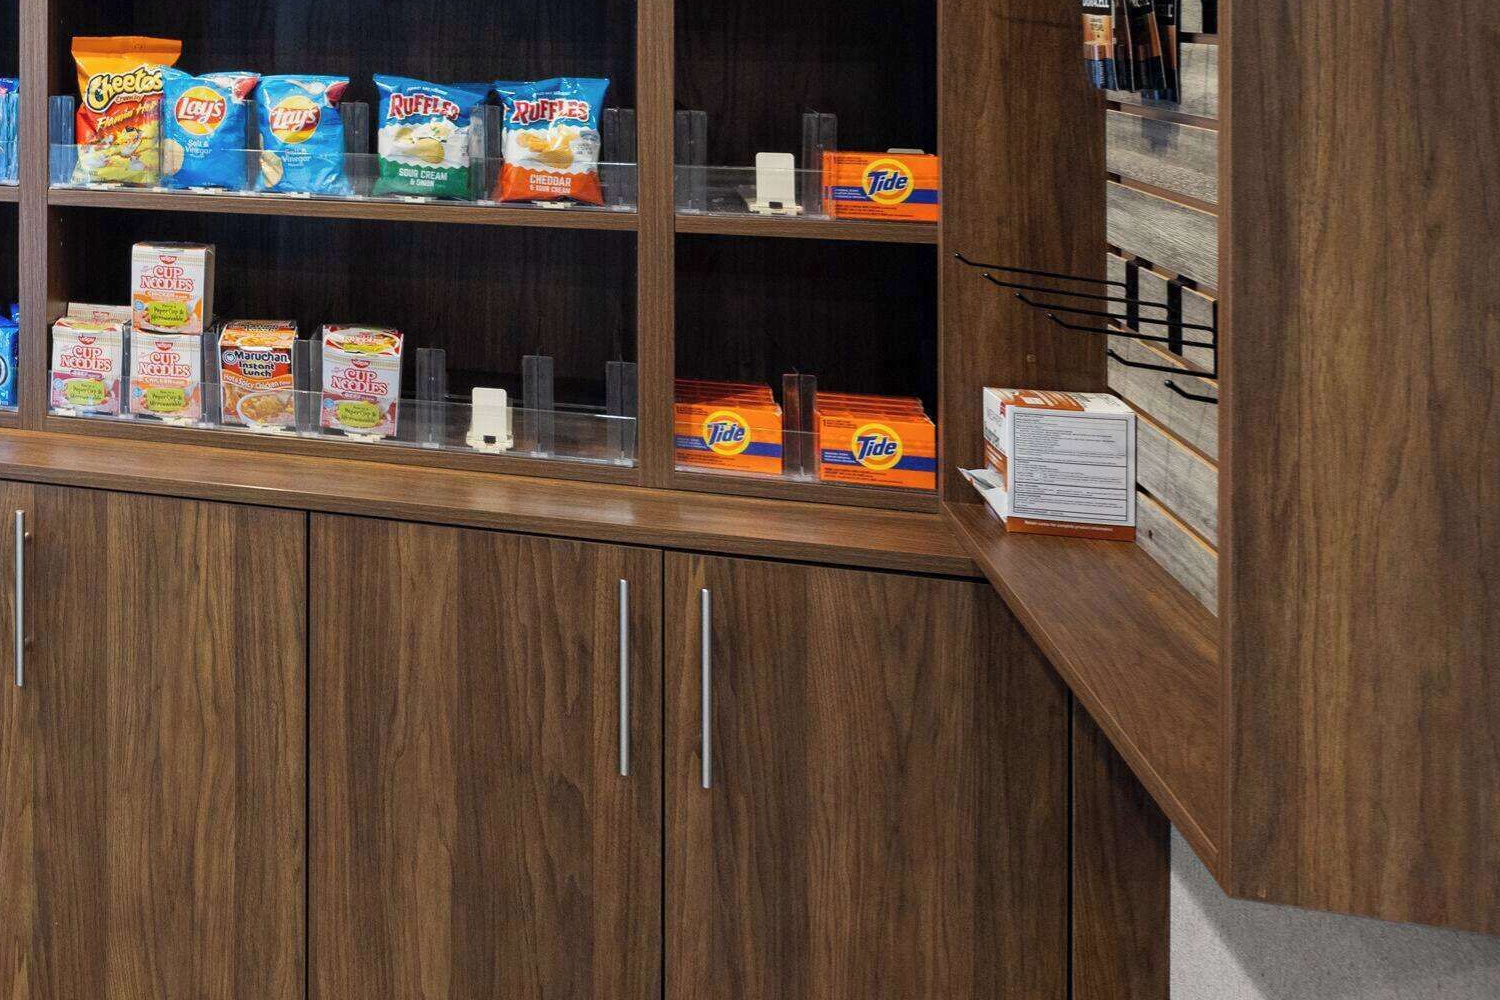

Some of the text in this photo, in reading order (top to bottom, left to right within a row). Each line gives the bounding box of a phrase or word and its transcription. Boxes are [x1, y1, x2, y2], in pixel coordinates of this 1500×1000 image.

[87, 66, 164, 112] Cheetos
[177, 99, 224, 124] Lay's
[389, 93, 460, 121] RUFFLES
[512, 99, 590, 124] RUFFLES
[398, 168, 447, 181] SOUR CREAM
[529, 173, 572, 187] CHEDDAR
[867, 170, 909, 197] Tide
[153, 264, 185, 279] CUP
[140, 274, 194, 293] NOODLES
[72, 345, 103, 359] CUP
[150, 351, 181, 366] CUP
[235, 350, 289, 363] Maruchan
[60, 354, 113, 373] NOODLES
[137, 361, 191, 379] NOODLES
[238, 361, 275, 371] Instant
[243, 368, 273, 378] Lunch
[344, 368, 377, 382] CUP
[331, 375, 388, 396] NOODLES
[707, 421, 747, 448] Tide
[857, 435, 899, 463] Tide
